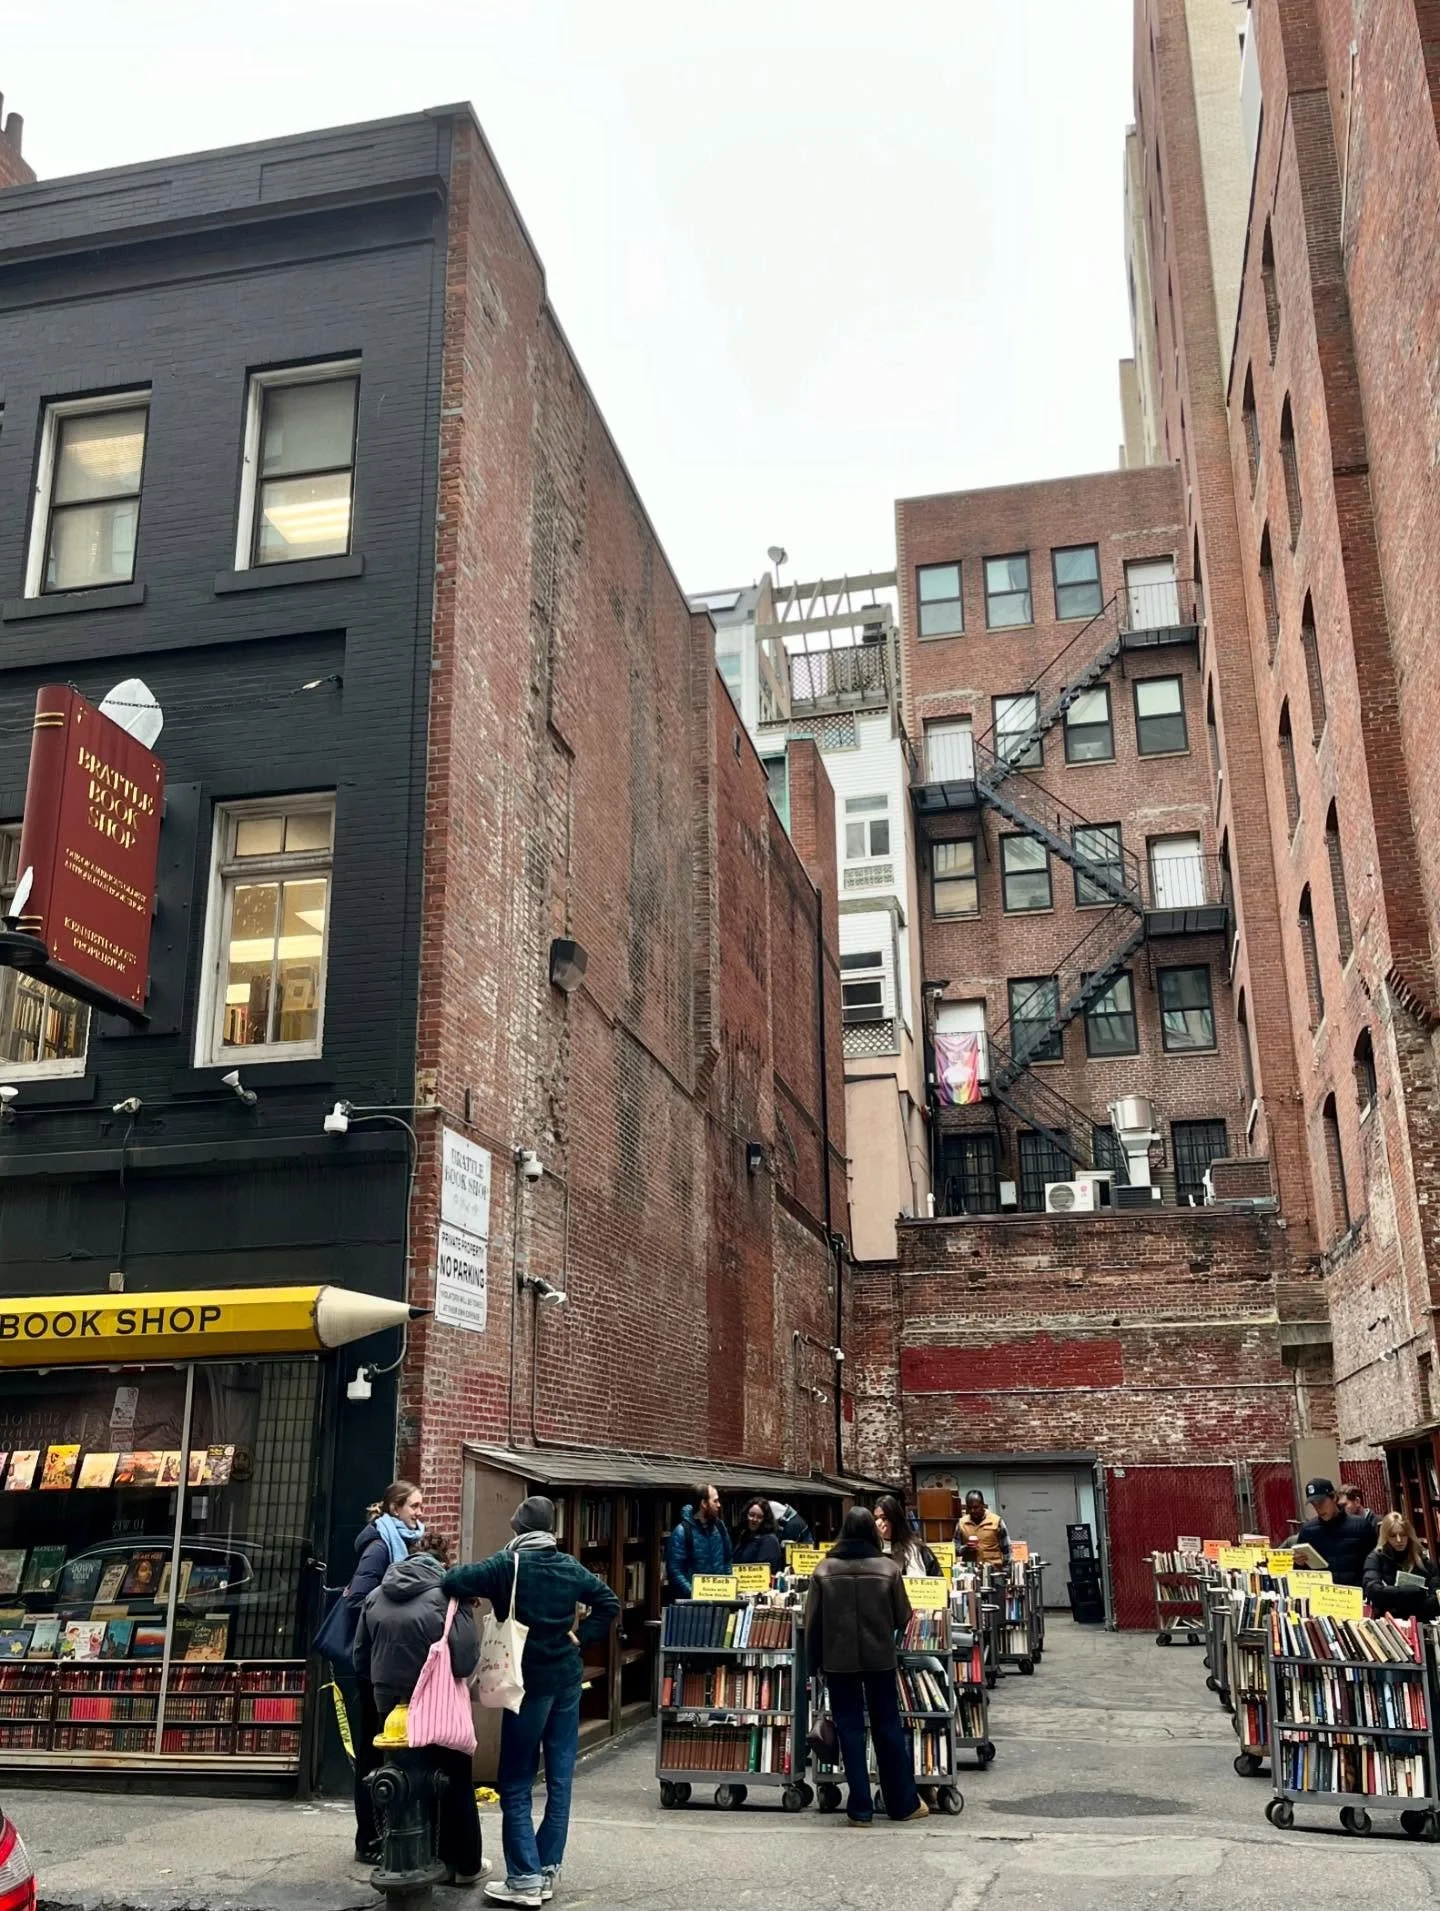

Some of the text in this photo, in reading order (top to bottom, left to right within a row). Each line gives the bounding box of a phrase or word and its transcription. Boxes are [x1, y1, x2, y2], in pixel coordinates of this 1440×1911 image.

[78, 746, 154, 816] BRATTLE
[89, 780, 140, 832] BOOK
[88, 806, 136, 850] SHOP
[64, 916, 137, 966] KENNETH GLOSS
[73, 937, 126, 974] PROPRIETOR
[451, 1147, 485, 1180] BRATTLE
[445, 1164, 489, 1201] BOOK SHOP
[441, 1231, 485, 1259] PRIVATE PROPERTY
[439, 1253, 485, 1289] NO PARKING
[0, 1305, 222, 1340] BOOK SHOP
[1332, 1586, 1353, 1596] Each
